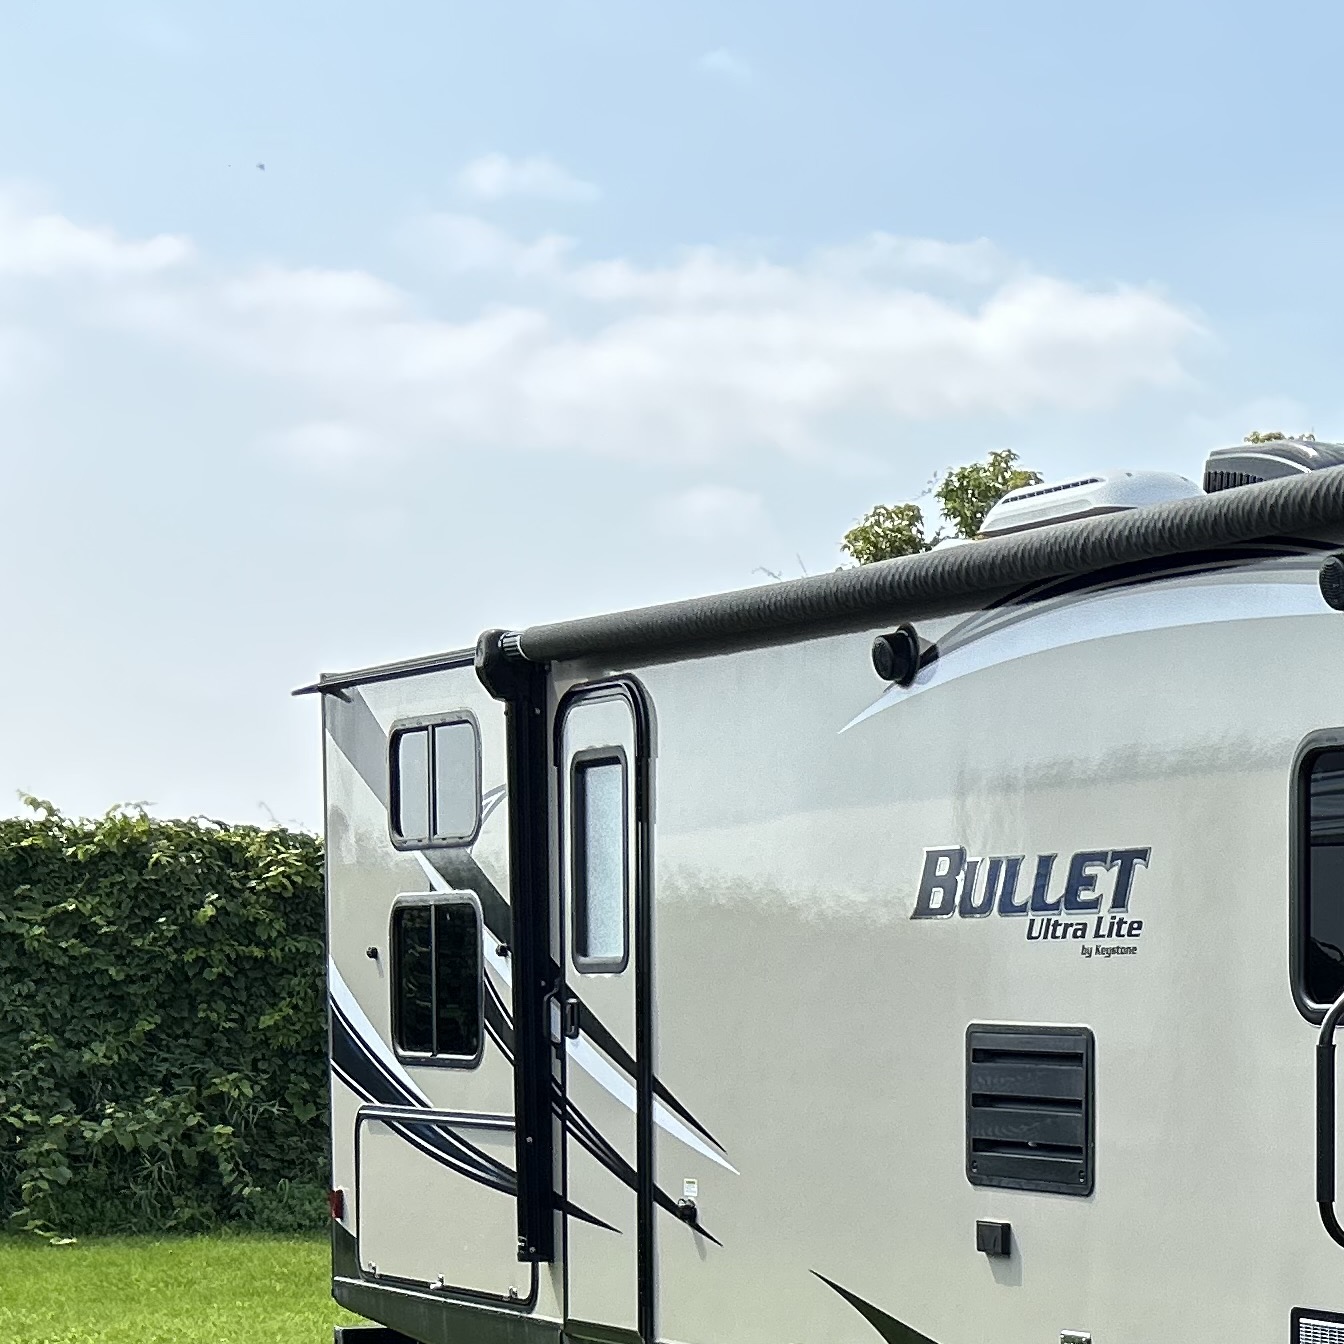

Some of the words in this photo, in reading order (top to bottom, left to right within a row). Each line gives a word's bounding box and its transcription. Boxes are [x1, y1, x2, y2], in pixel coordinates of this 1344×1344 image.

[909, 845, 1152, 919] BULLET
[1026, 917, 1088, 940] Ultra
[1093, 916, 1143, 938] Lite
[1081, 945, 1093, 958] by
[1095, 945, 1138, 958] Keystone
